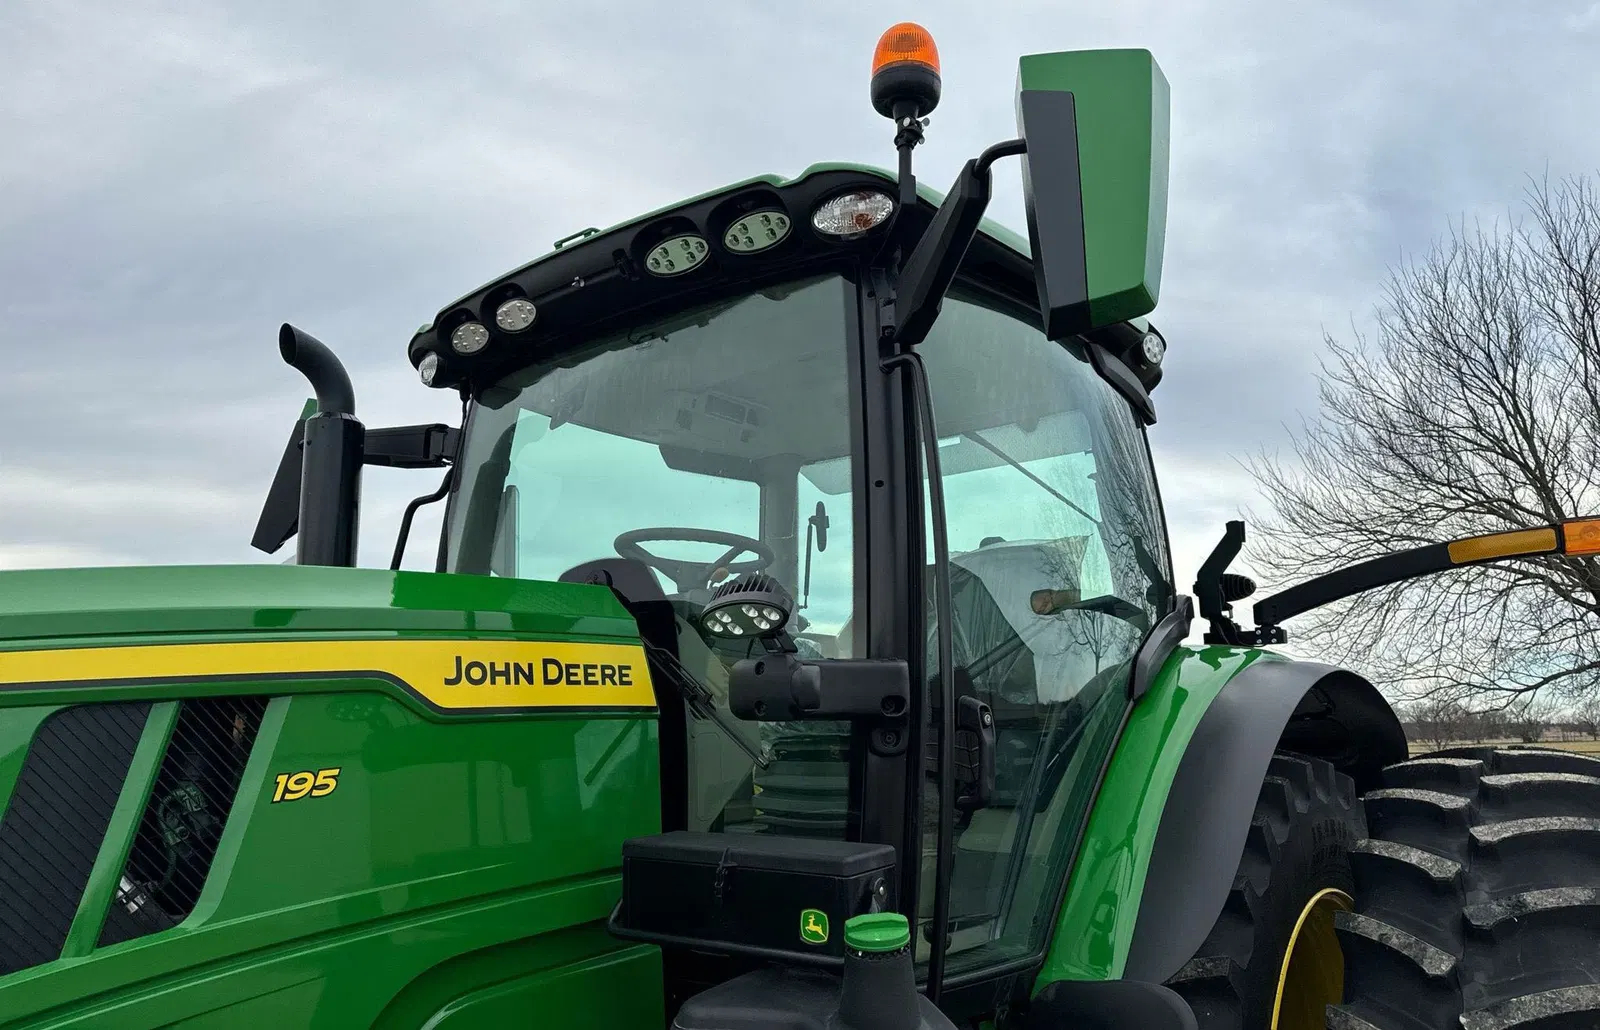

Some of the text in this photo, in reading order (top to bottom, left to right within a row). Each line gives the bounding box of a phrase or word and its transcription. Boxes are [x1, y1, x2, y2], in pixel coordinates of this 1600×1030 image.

[444, 655, 633, 686] JOHN DEERE
[272, 768, 341, 802] 195
